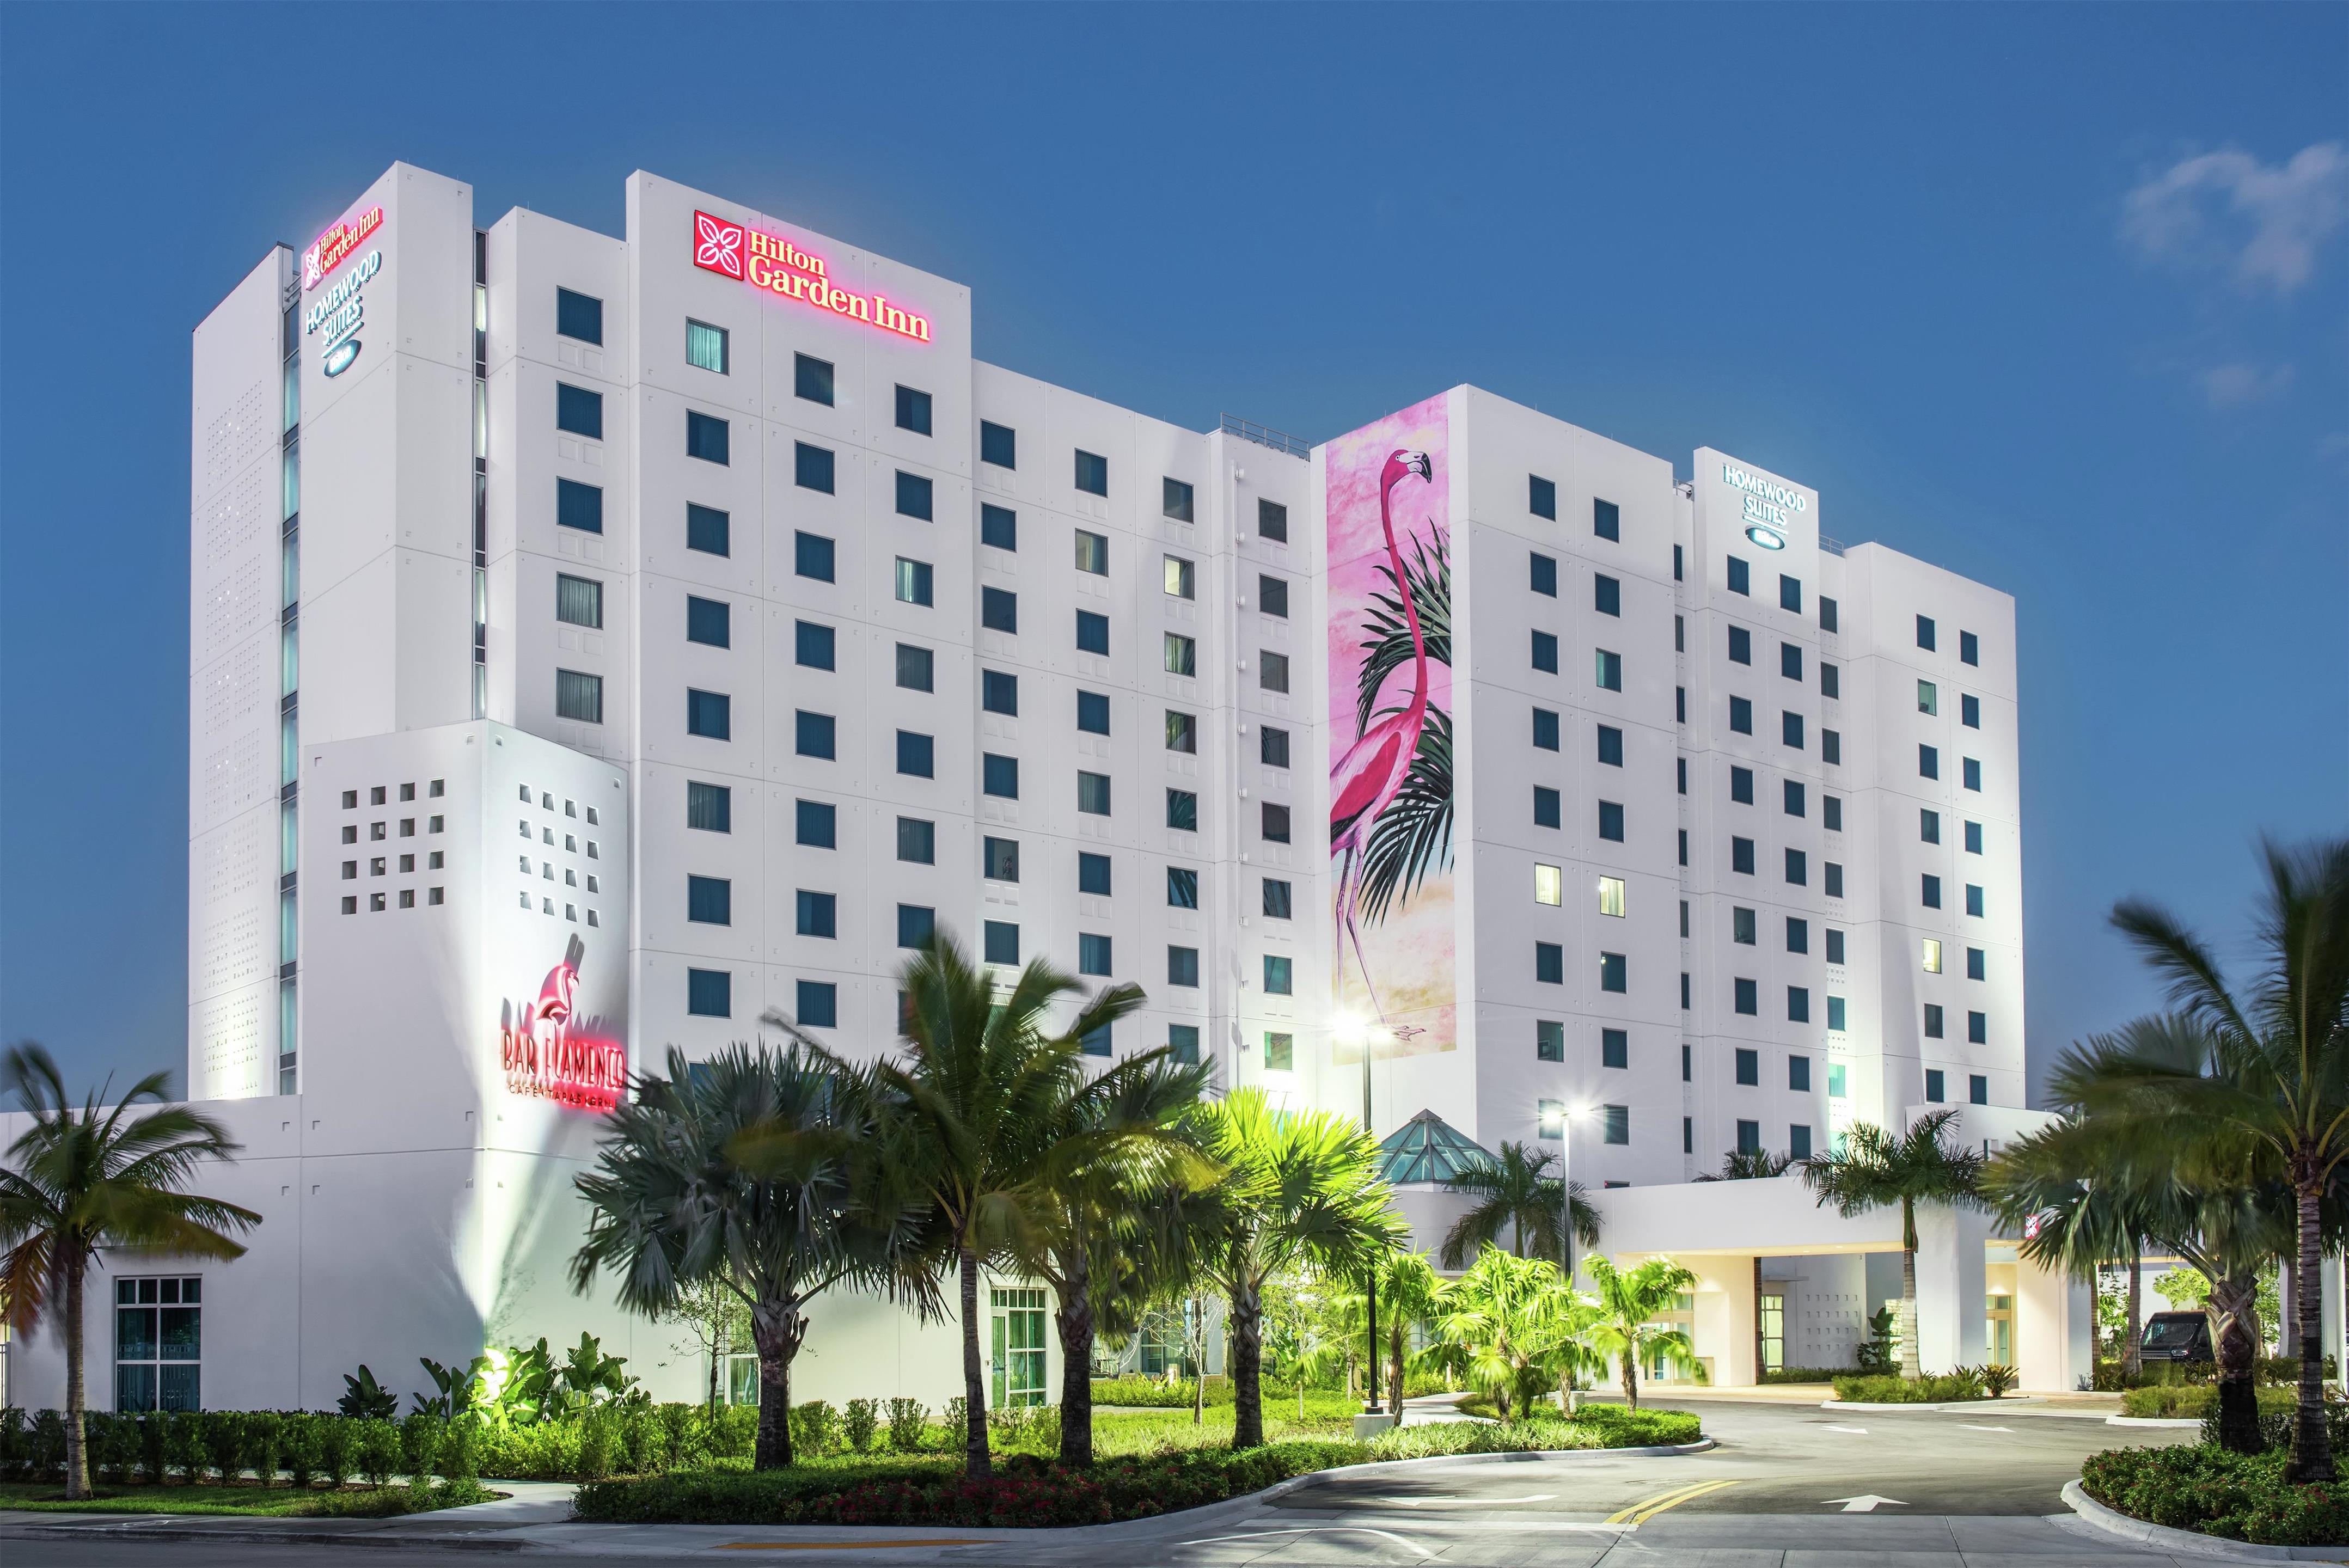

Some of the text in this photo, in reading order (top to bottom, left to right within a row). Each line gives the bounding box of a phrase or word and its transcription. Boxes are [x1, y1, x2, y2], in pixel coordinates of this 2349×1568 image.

[320, 223, 344, 254] Hilton
[320, 206, 380, 273] Garden Inn
[749, 230, 825, 276] Hilton
[306, 250, 381, 335] HOMEWOOD
[748, 255, 930, 341] Garden Inn
[323, 295, 363, 346] SUITES
[1723, 464, 1806, 512] HOMEWOOD
[1744, 496, 1787, 526] SUITES
[501, 1029, 626, 1088] BAR FLAMENCO
[509, 1084, 538, 1098] CAFÉ
